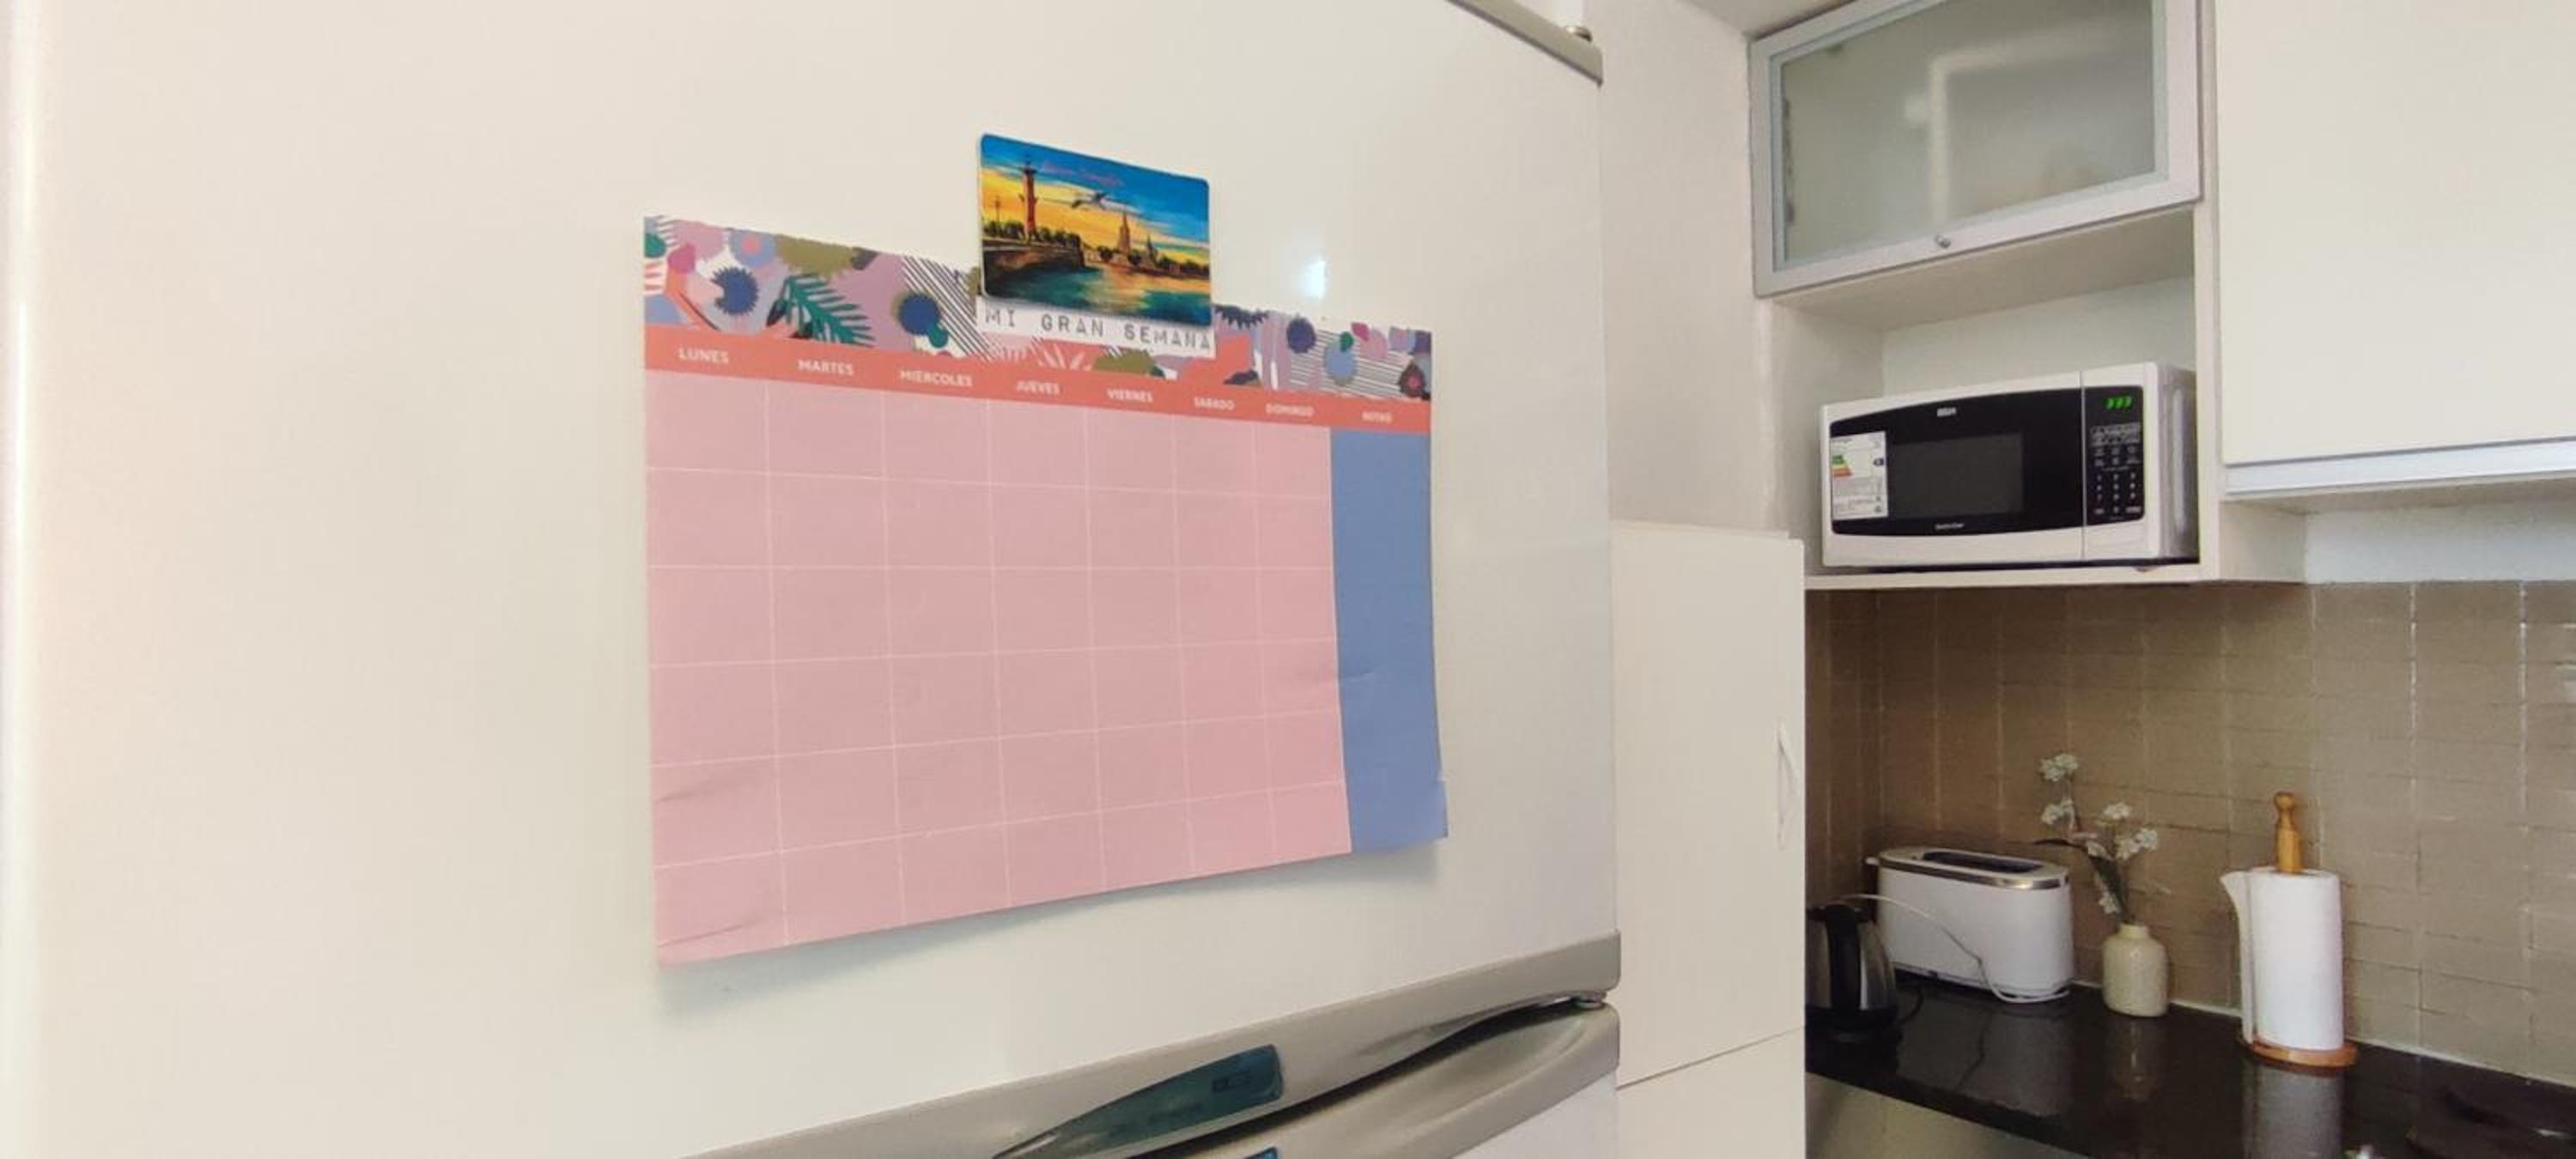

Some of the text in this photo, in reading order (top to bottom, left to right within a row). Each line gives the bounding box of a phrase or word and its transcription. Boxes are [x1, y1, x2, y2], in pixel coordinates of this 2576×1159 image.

[985, 307, 1212, 351] MI GRAN SEMANA
[678, 347, 730, 365] LUNES
[798, 359, 854, 376] MARTES
[1016, 379, 1060, 395] JUEVES
[1107, 388, 1154, 403] VIERNES
